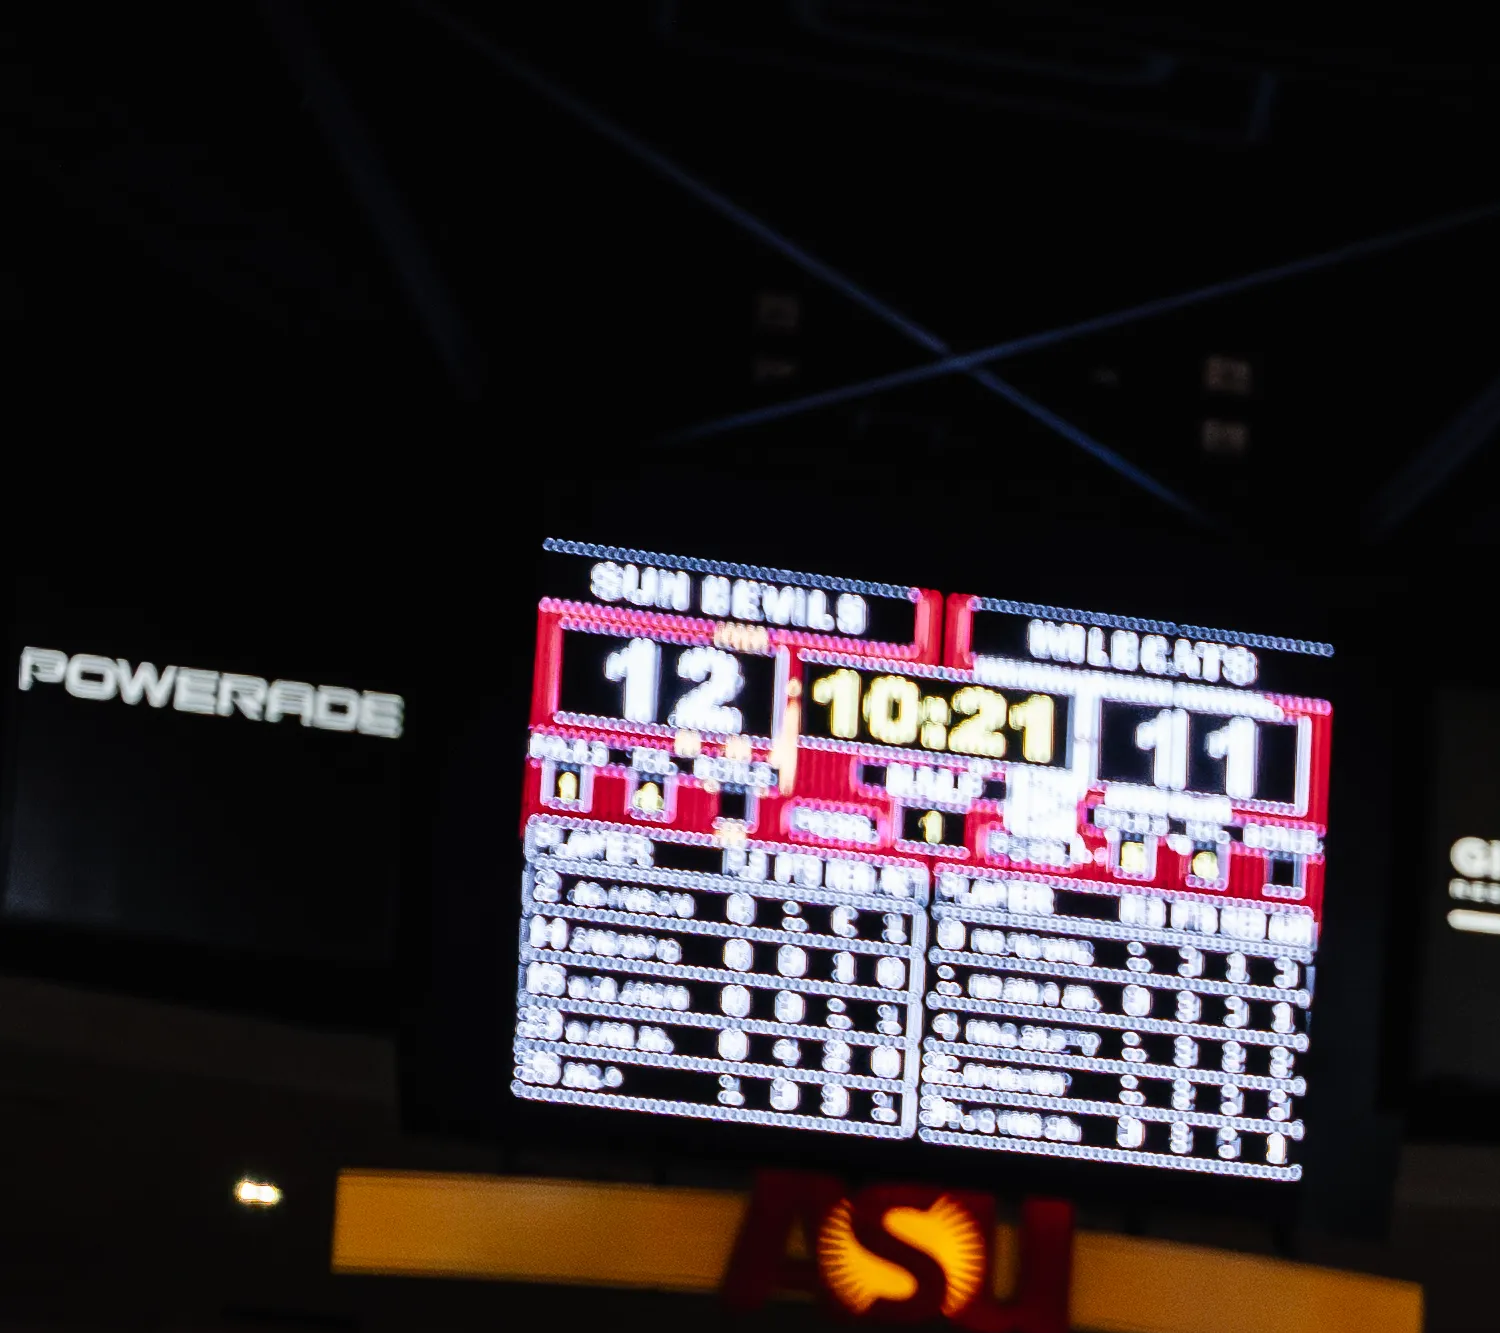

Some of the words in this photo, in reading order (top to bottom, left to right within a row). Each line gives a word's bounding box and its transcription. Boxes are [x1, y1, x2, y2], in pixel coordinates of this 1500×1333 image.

[590, 560, 691, 611] SUN
[18, 646, 405, 739] POWERADE
[604, 637, 745, 735] 12
[1028, 618, 1259, 686] WILDCATS
[812, 668, 1056, 764] 10:21
[1135, 707, 1260, 799] 11
